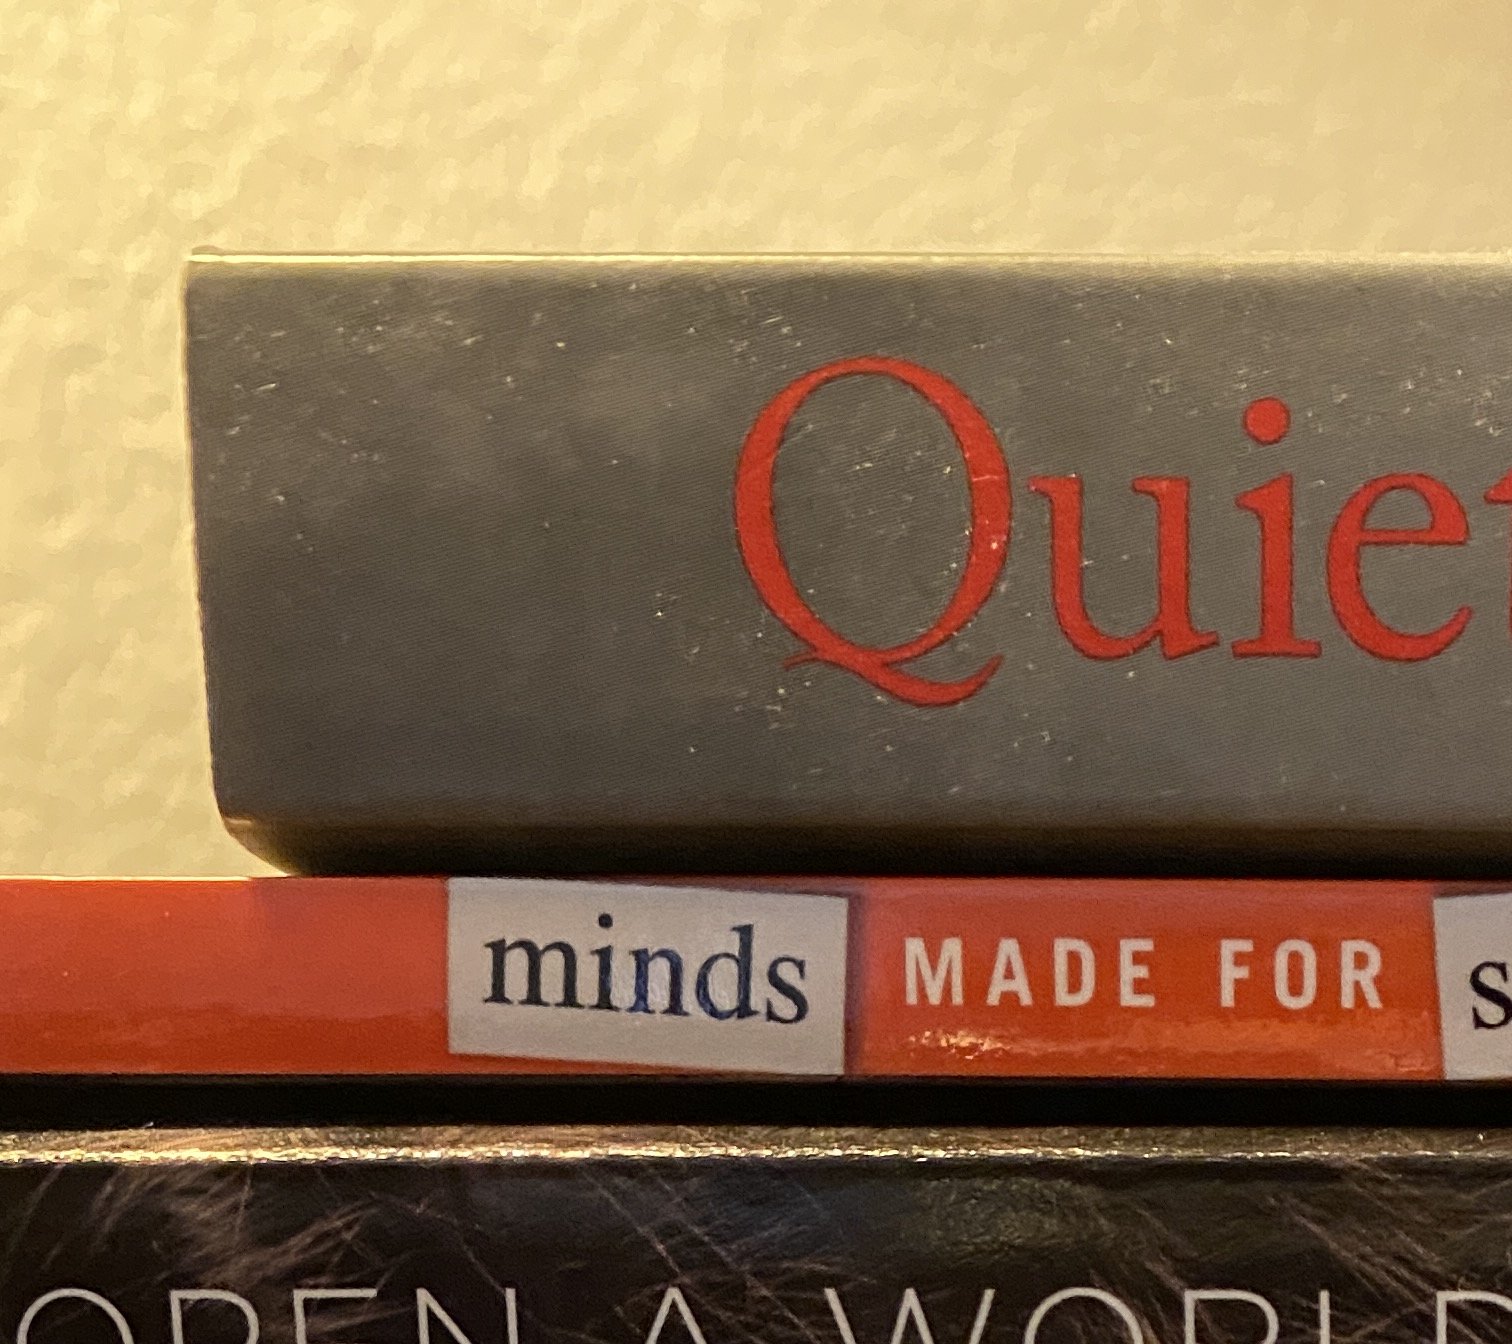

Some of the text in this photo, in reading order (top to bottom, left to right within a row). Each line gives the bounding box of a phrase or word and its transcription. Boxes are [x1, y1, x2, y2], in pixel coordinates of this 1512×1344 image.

[483, 913, 809, 1025] minds
[904, 937, 1156, 1008] MADE
[1219, 939, 1383, 1010] FOR
